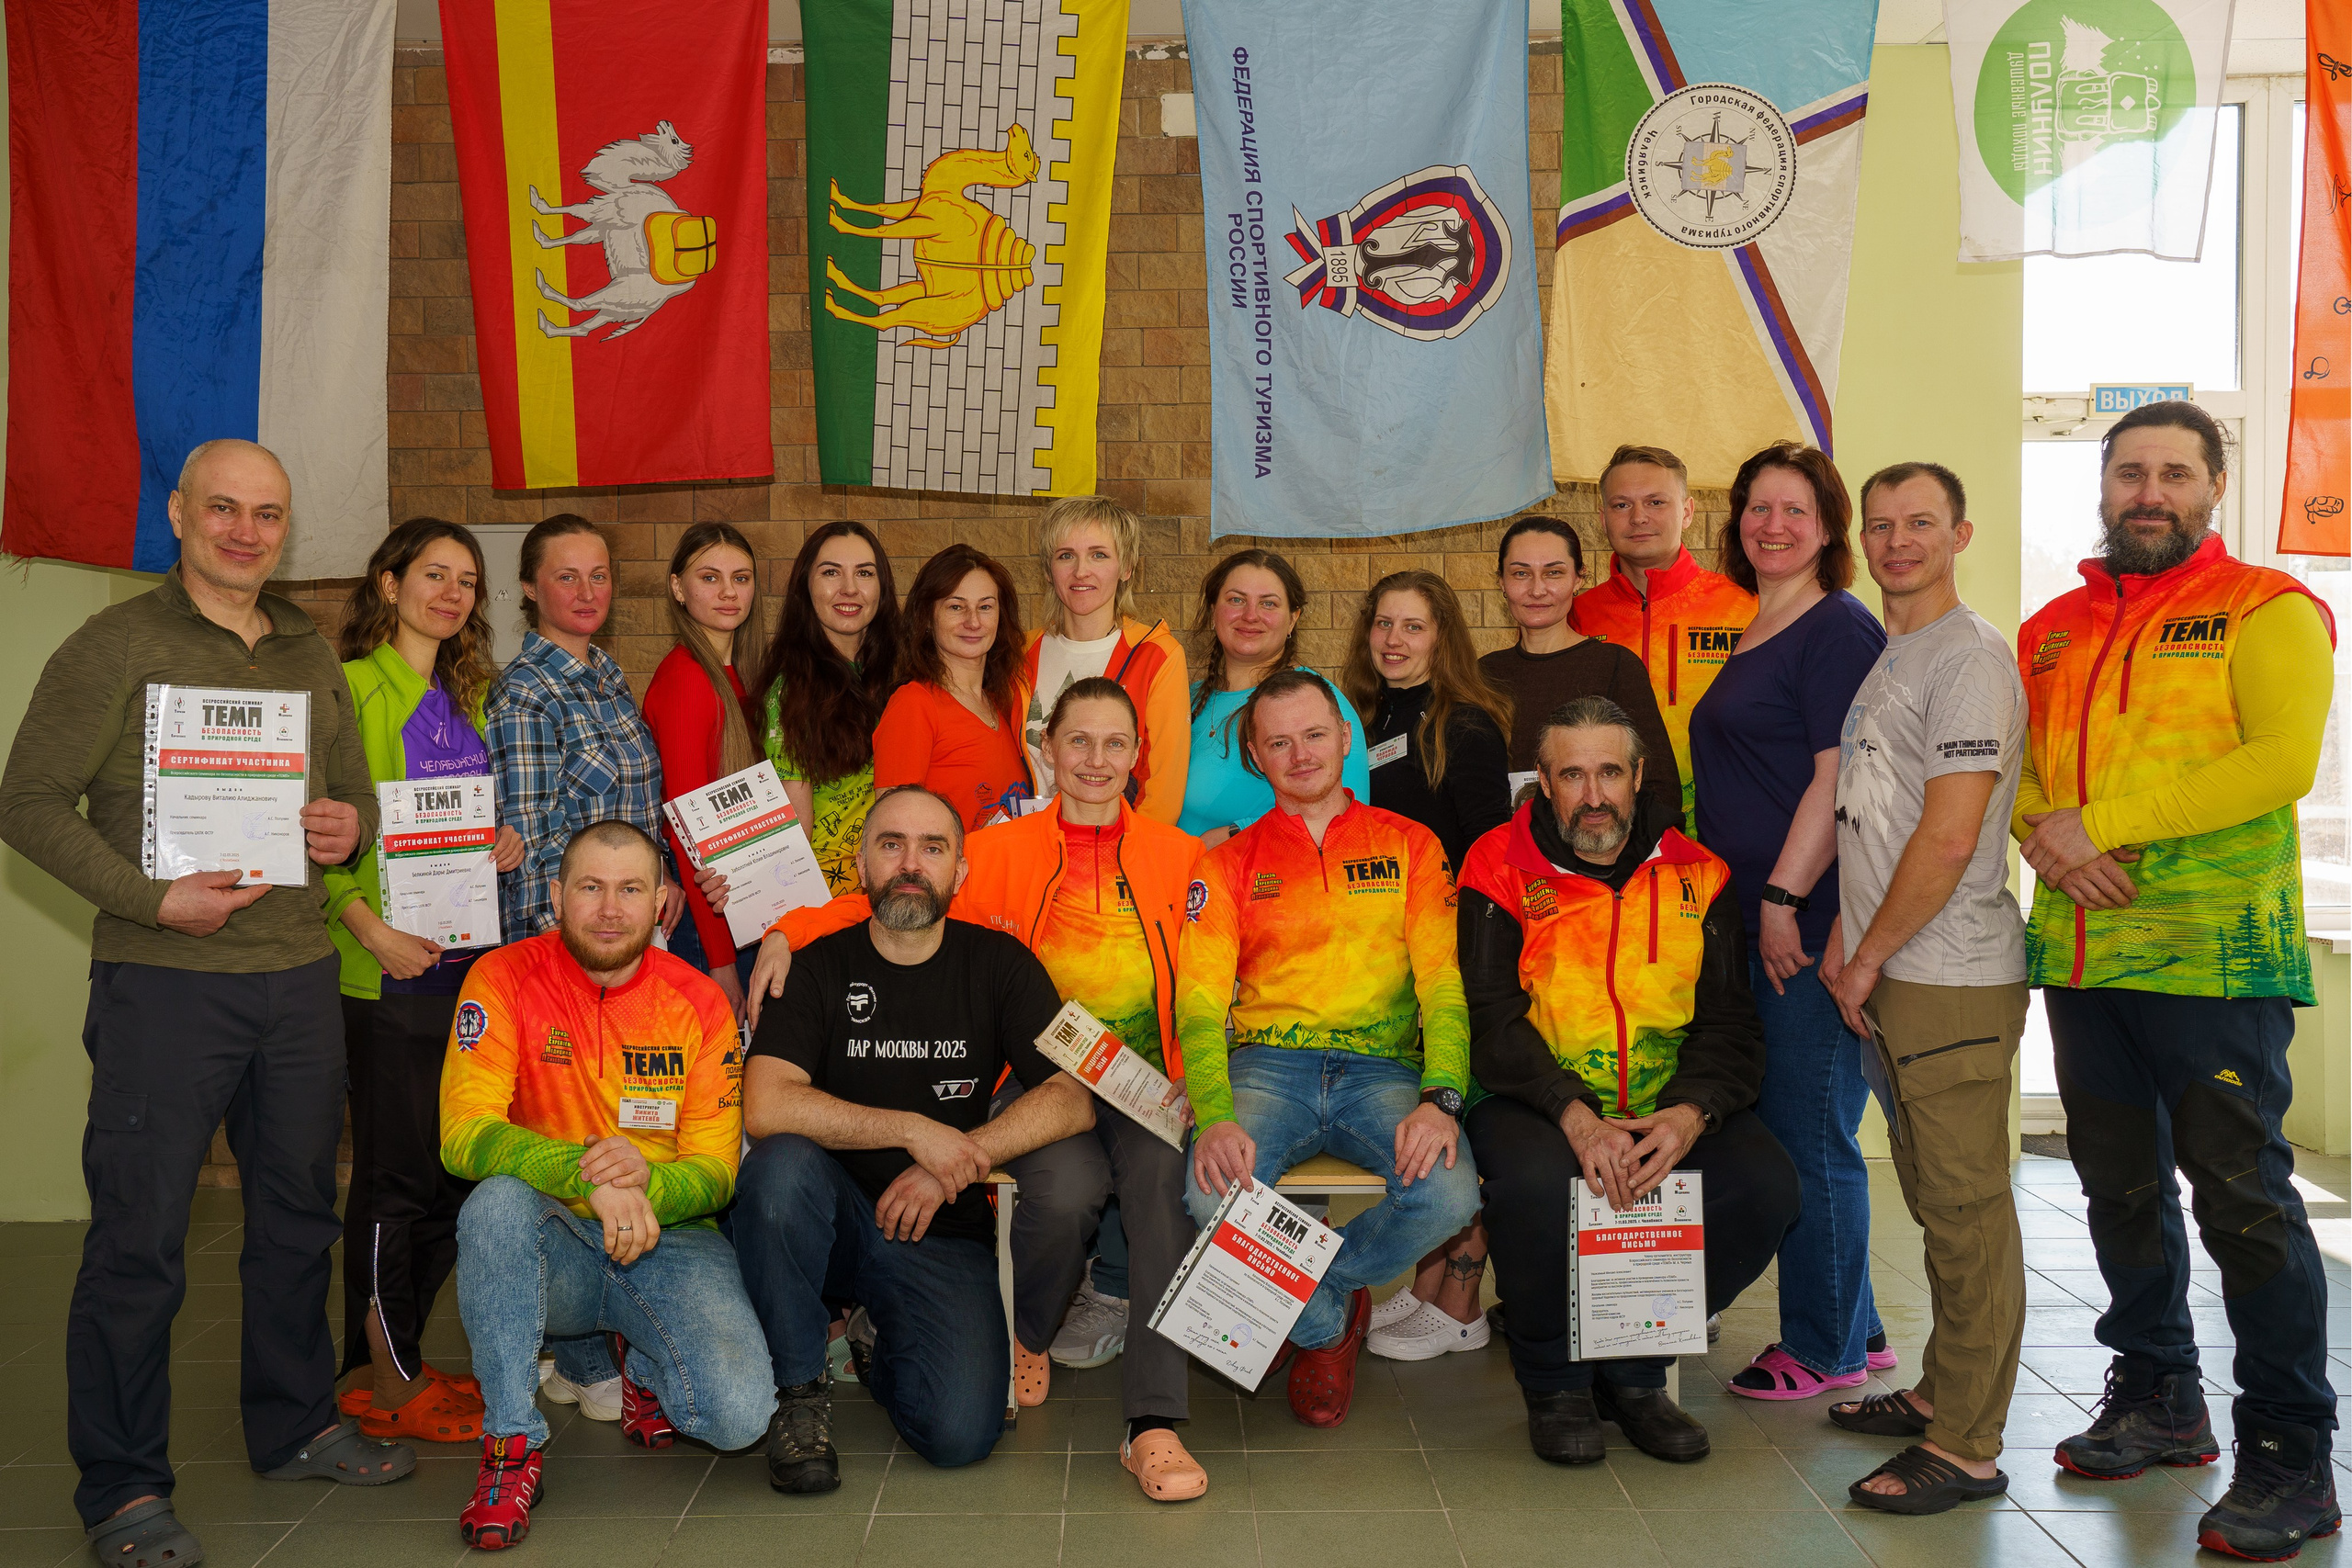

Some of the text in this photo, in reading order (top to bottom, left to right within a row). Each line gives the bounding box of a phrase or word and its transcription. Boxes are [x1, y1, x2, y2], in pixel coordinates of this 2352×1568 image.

[2007, 52, 2029, 171] ДУШЕВНЫЕ ПОХОДЫ
[2028, 41, 2053, 175] ПОЛУНИН
[1637, 130, 1658, 199] Челябинск
[1680, 95, 1787, 239] Городская федерация спортивного туризма
[1227, 213, 1248, 309] РОССИИ
[1232, 46, 1272, 479] ФЕДЕРАЦИЯ СПОРТИВНОГО ТУРИЗМА
[1330, 251, 1349, 283] 1895
[2159, 617, 2228, 643] ТЕМП
[2154, 643, 2223, 652] БЕЗОПАСНОСТЬ
[202, 705, 262, 728] ТЕМП
[201, 728, 262, 736] БЕЗОПАСНОСТЬ
[1943, 740, 1958, 750] MAIN
[1958, 739, 1977, 749] THING
[1977, 739, 1984, 749] IS
[1943, 748, 1998, 760] NOT PARTICIPATION
[170, 756, 290, 767] СЕРТИФИКАТ УЧАСТНИКА
[419, 750, 488, 773] ЧЕЛЯБИНСКИЙ
[414, 791, 462, 811] ТЕМП
[707, 782, 753, 813] ТЕМП
[716, 799, 757, 819] БЕЗОПАСНОСТЬ
[415, 810, 462, 818] БЕЗОПАСНОСТЬ
[393, 833, 485, 847] СЕРТИФИКАТ УЧАСТНИКА
[707, 828, 749, 852] СЕРТИФИКАТ
[750, 812, 786, 832] УЧАСТНИКА
[1343, 860, 1400, 882] ТЕМП
[1347, 880, 1400, 890] БЕЗОПАСНОСТЬ
[1054, 1021, 1080, 1047] ТЕМП
[847, 1039, 967, 1059] ПАР МОСКВЫ 2025
[622, 1051, 684, 1077] ТЕМП
[623, 1077, 684, 1086] БЕЗОПАСНОСТЬ
[1261, 1222, 1298, 1250] БЕЗОПАСНОСТЬ
[1267, 1205, 1309, 1244] ТЕМП
[1596, 1230, 1682, 1242] БЛАГОДАРСТВЕННОЕ
[1261, 1229, 1283, 1248] ПРИРОДНОЙ
[1283, 1242, 1295, 1255] СРЕДЕ
[1622, 1240, 1657, 1249] ПИСЬМО
[1231, 1233, 1301, 1283] БЛАГОДАРСТВЕННОЕ
[1247, 1253, 1276, 1278] ПИСЬМО
